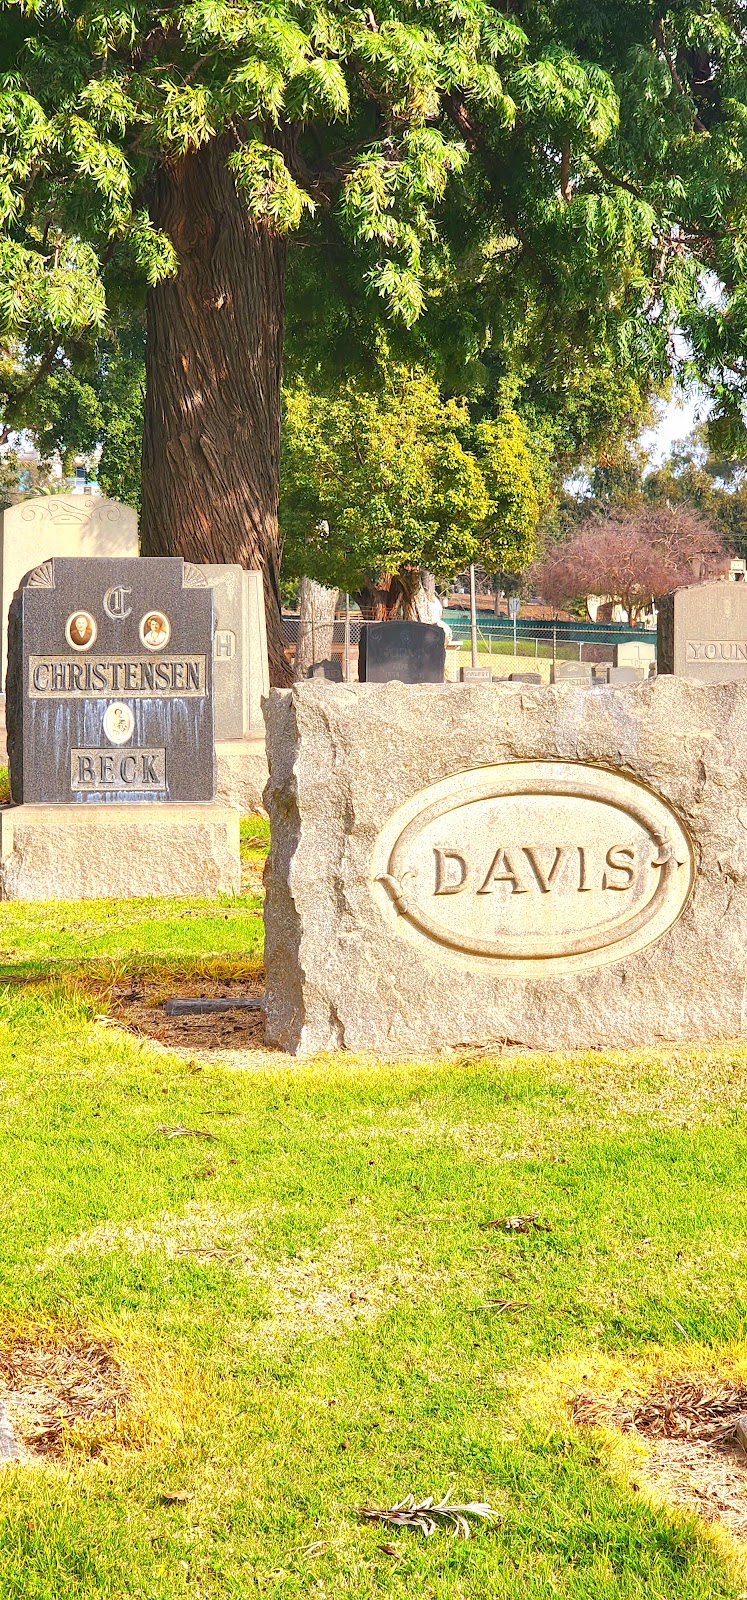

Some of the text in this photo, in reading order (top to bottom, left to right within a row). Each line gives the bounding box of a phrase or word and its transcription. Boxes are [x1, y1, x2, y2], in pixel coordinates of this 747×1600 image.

[33, 661, 200, 692] CHRISTENSEN
[78, 754, 160, 784] BECK
[432, 843, 636, 896] DAVIS
